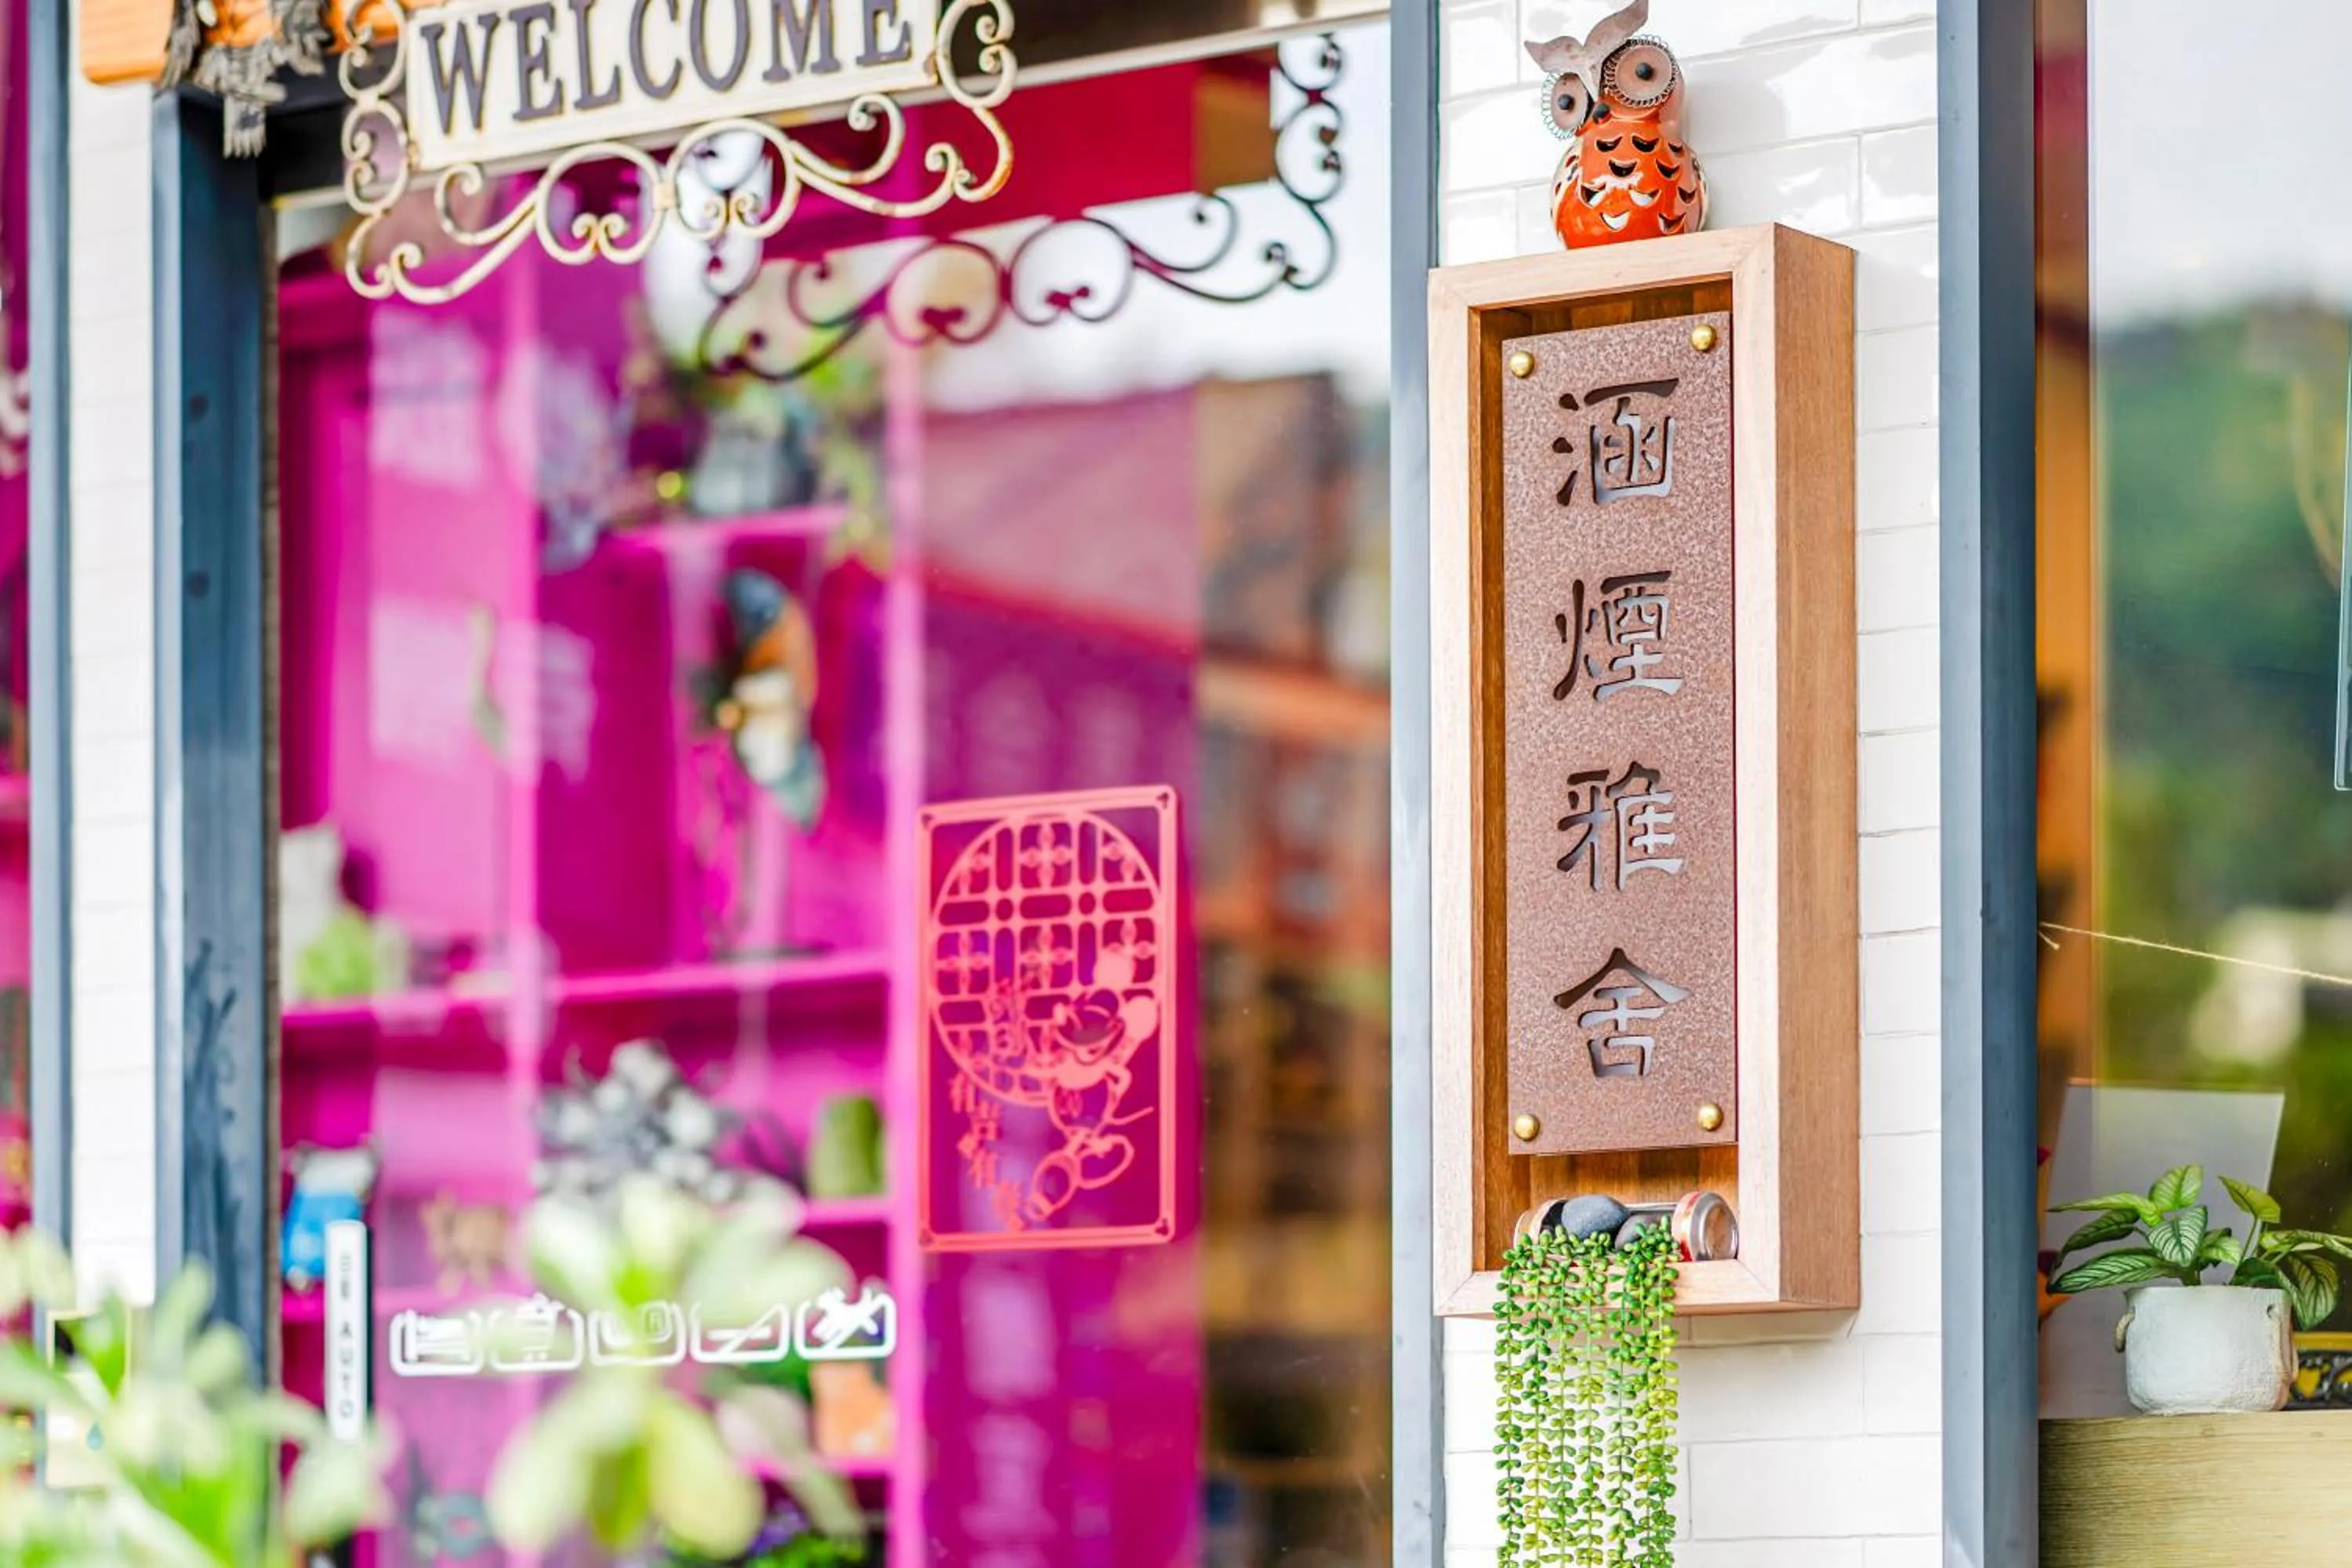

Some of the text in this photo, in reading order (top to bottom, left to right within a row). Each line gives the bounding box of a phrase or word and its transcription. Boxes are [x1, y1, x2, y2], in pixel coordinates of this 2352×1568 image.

[420, 0, 913, 135] WELCOME
[1552, 377, 1691, 1079] 涵煙雅舍
